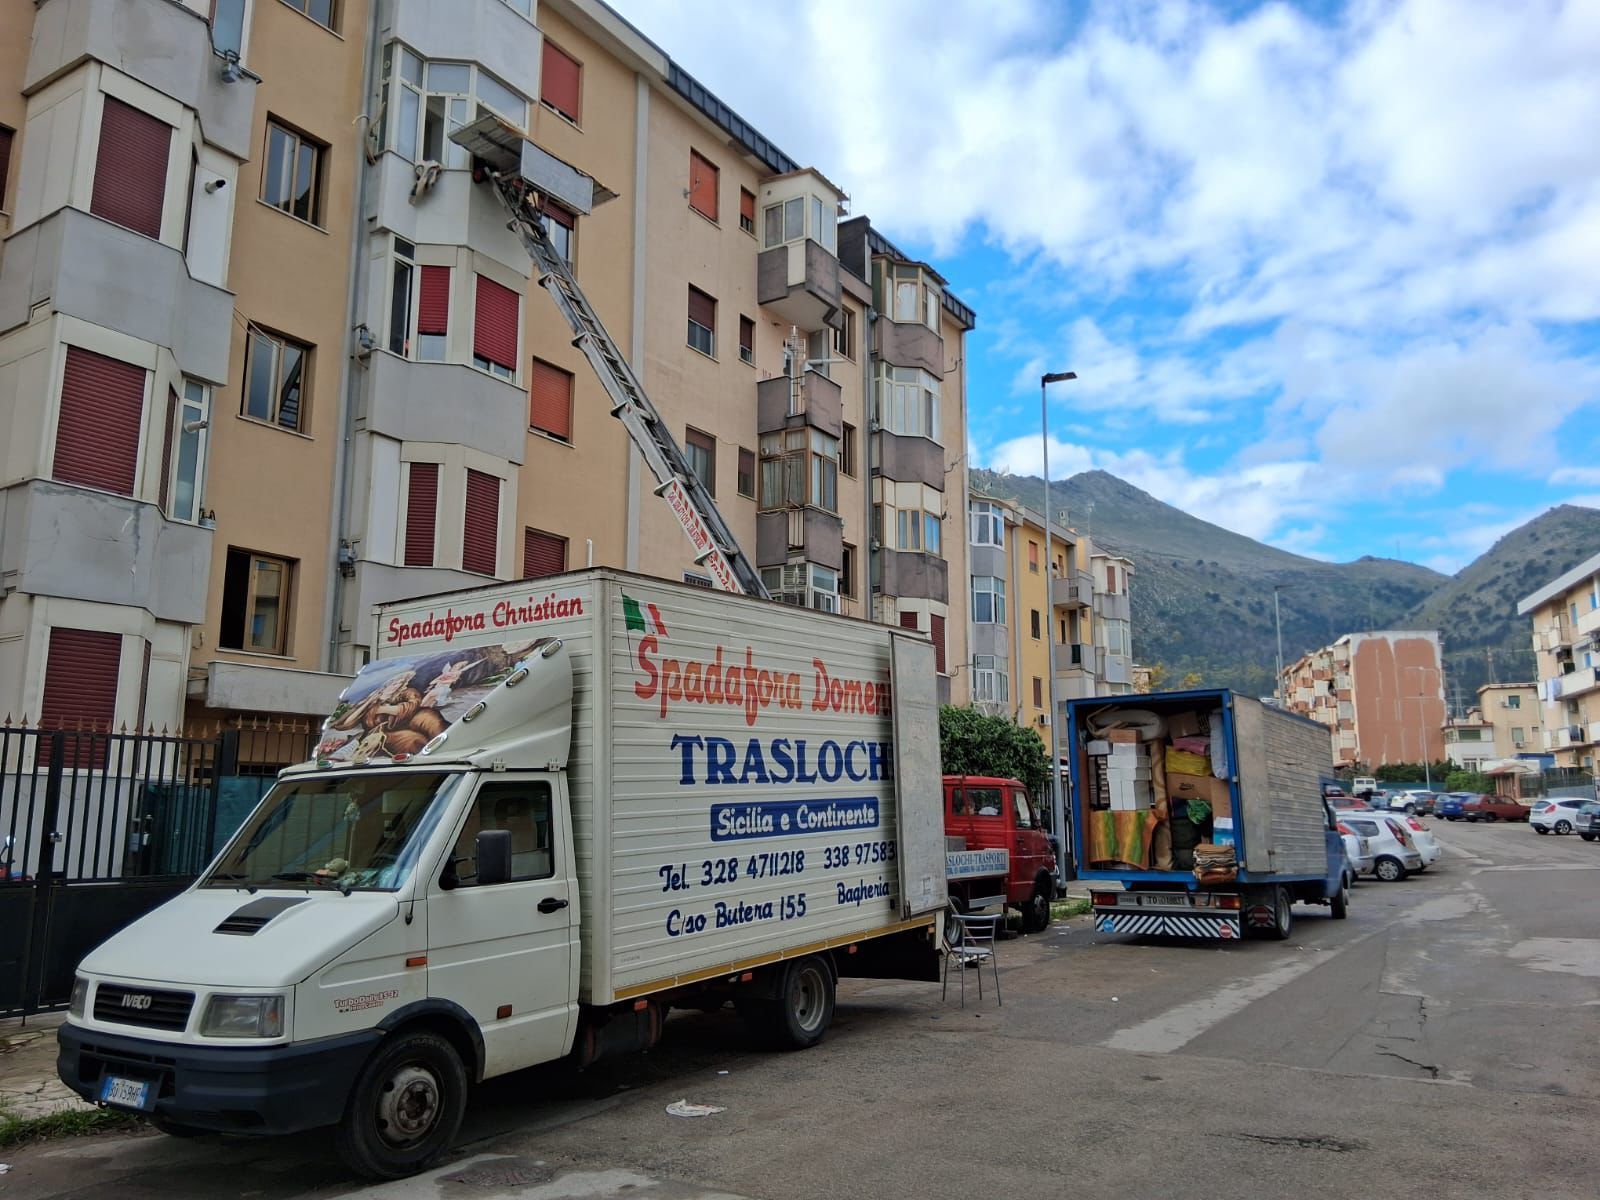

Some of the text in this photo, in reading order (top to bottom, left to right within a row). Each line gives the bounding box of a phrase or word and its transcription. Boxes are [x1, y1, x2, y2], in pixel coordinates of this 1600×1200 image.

[387, 592, 584, 647] Spadafora Christian
[634, 633, 803, 727] Spadafora
[716, 803, 876, 836] Sicilia e Continente
[659, 841, 897, 892] Tel. 328 4711218 338 97583
[714, 900, 774, 928] Butera
[780, 893, 807, 921] 155
[836, 876, 890, 907] Bagheria
[121, 993, 153, 1010] IVECO
